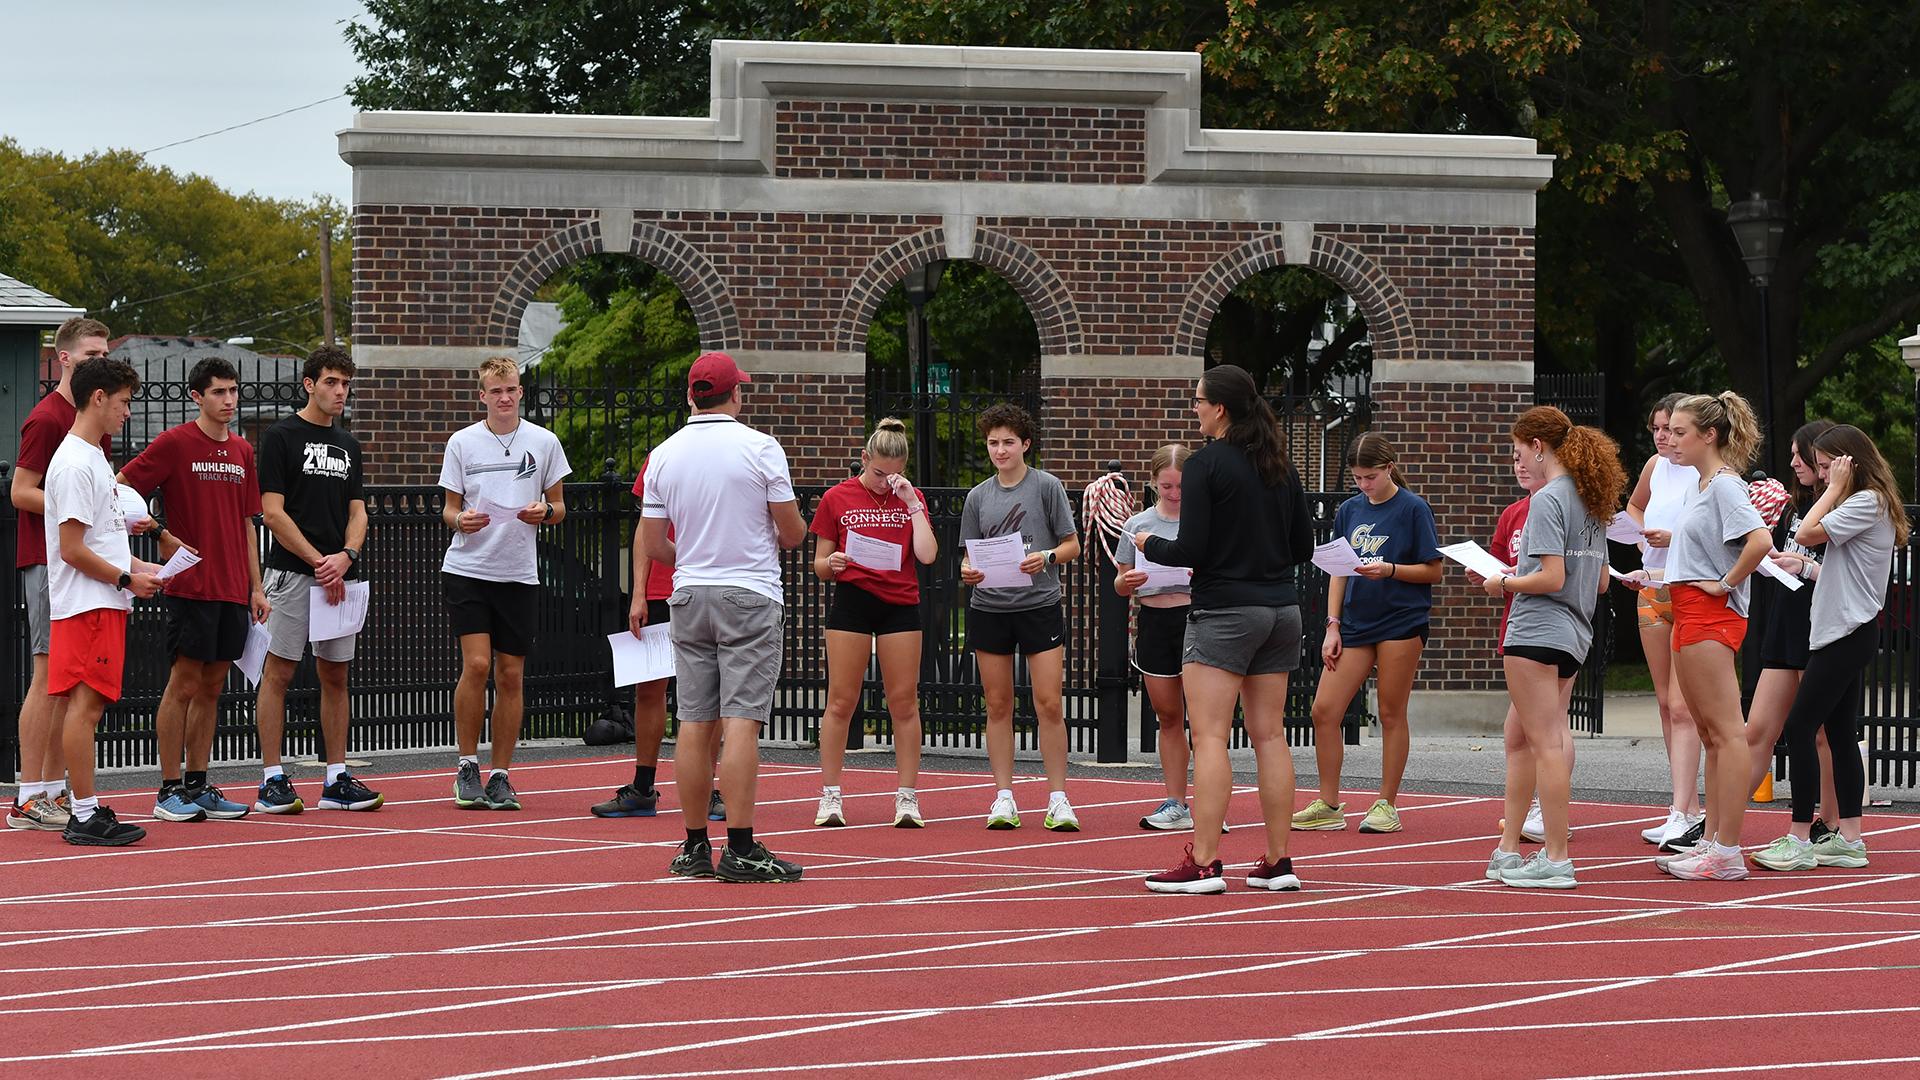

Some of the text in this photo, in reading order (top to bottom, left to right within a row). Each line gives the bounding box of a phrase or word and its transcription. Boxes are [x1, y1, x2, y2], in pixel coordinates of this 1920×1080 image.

[303, 444, 346, 471] 2nd WIND
[198, 472, 222, 481] TRACK
[222, 474, 228, 482] &
[840, 512, 909, 526] CONNECT
[1350, 522, 1390, 557] GW
[1359, 556, 1385, 566] CROSSE
